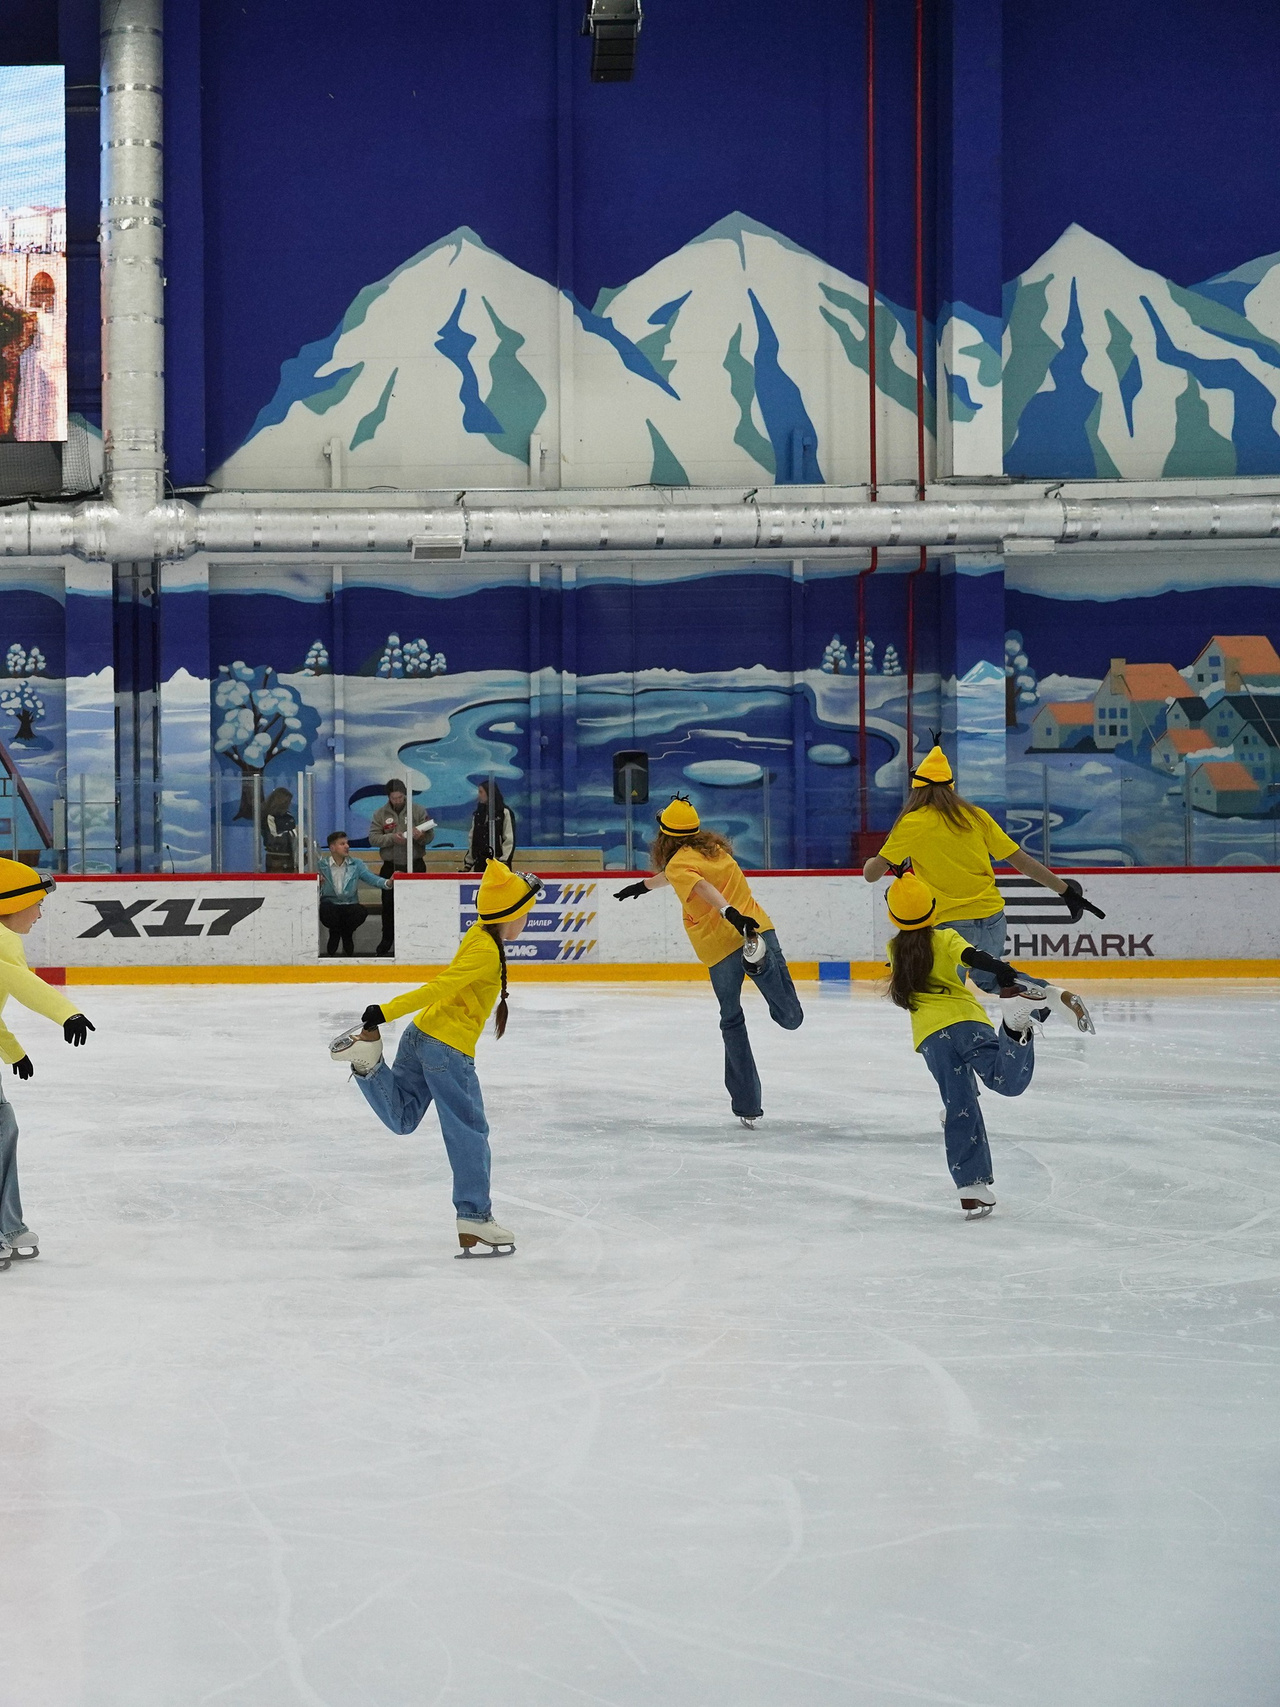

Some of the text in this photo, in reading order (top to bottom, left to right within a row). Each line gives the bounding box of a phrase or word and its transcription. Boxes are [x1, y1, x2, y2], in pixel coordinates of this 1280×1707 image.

[75, 897, 266, 939] X17
[527, 919, 553, 927] ДИЛЕР
[504, 944, 538, 957] CMG
